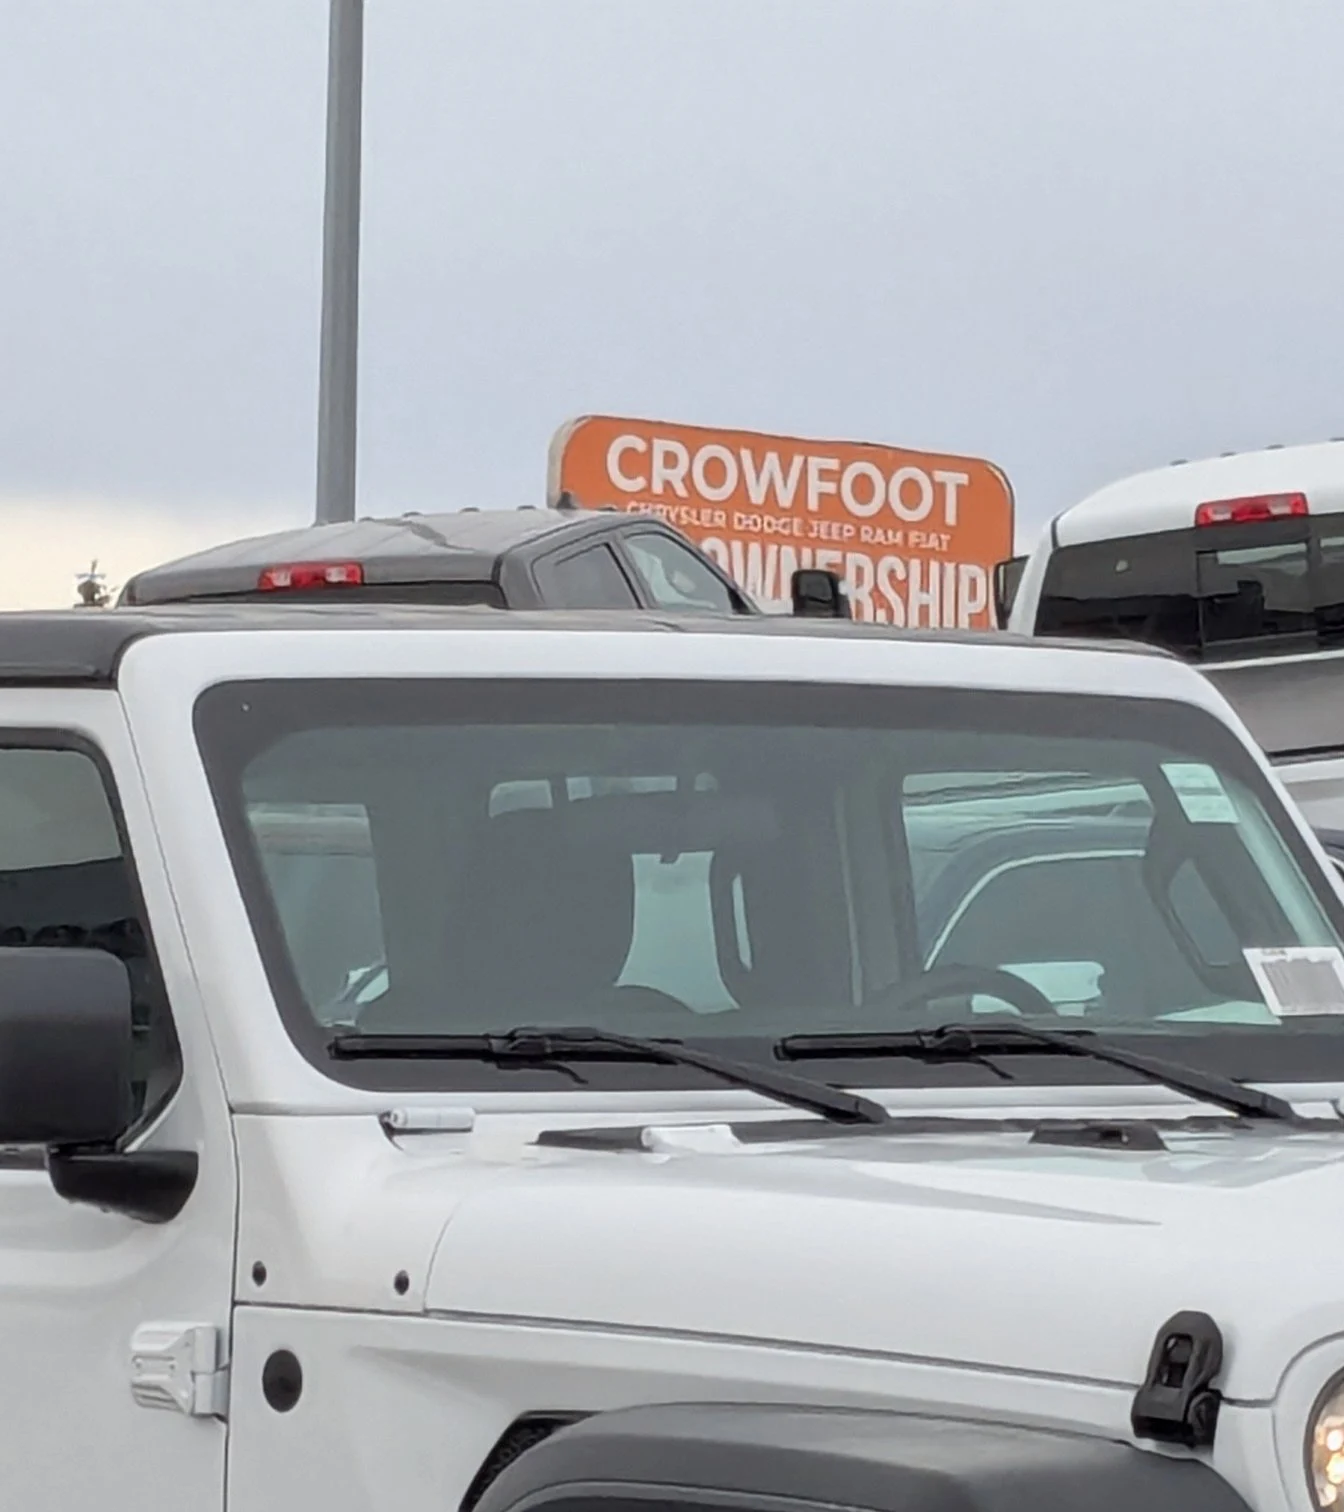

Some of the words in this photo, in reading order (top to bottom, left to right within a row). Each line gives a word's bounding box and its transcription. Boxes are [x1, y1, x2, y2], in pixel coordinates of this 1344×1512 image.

[606, 434, 969, 526] CROWFOOT
[626, 500, 727, 528] CHRYSLER
[733, 512, 804, 537] DODGE
[808, 519, 856, 542] JEEP
[860, 525, 903, 546] RAM
[908, 530, 951, 551] FIAT
